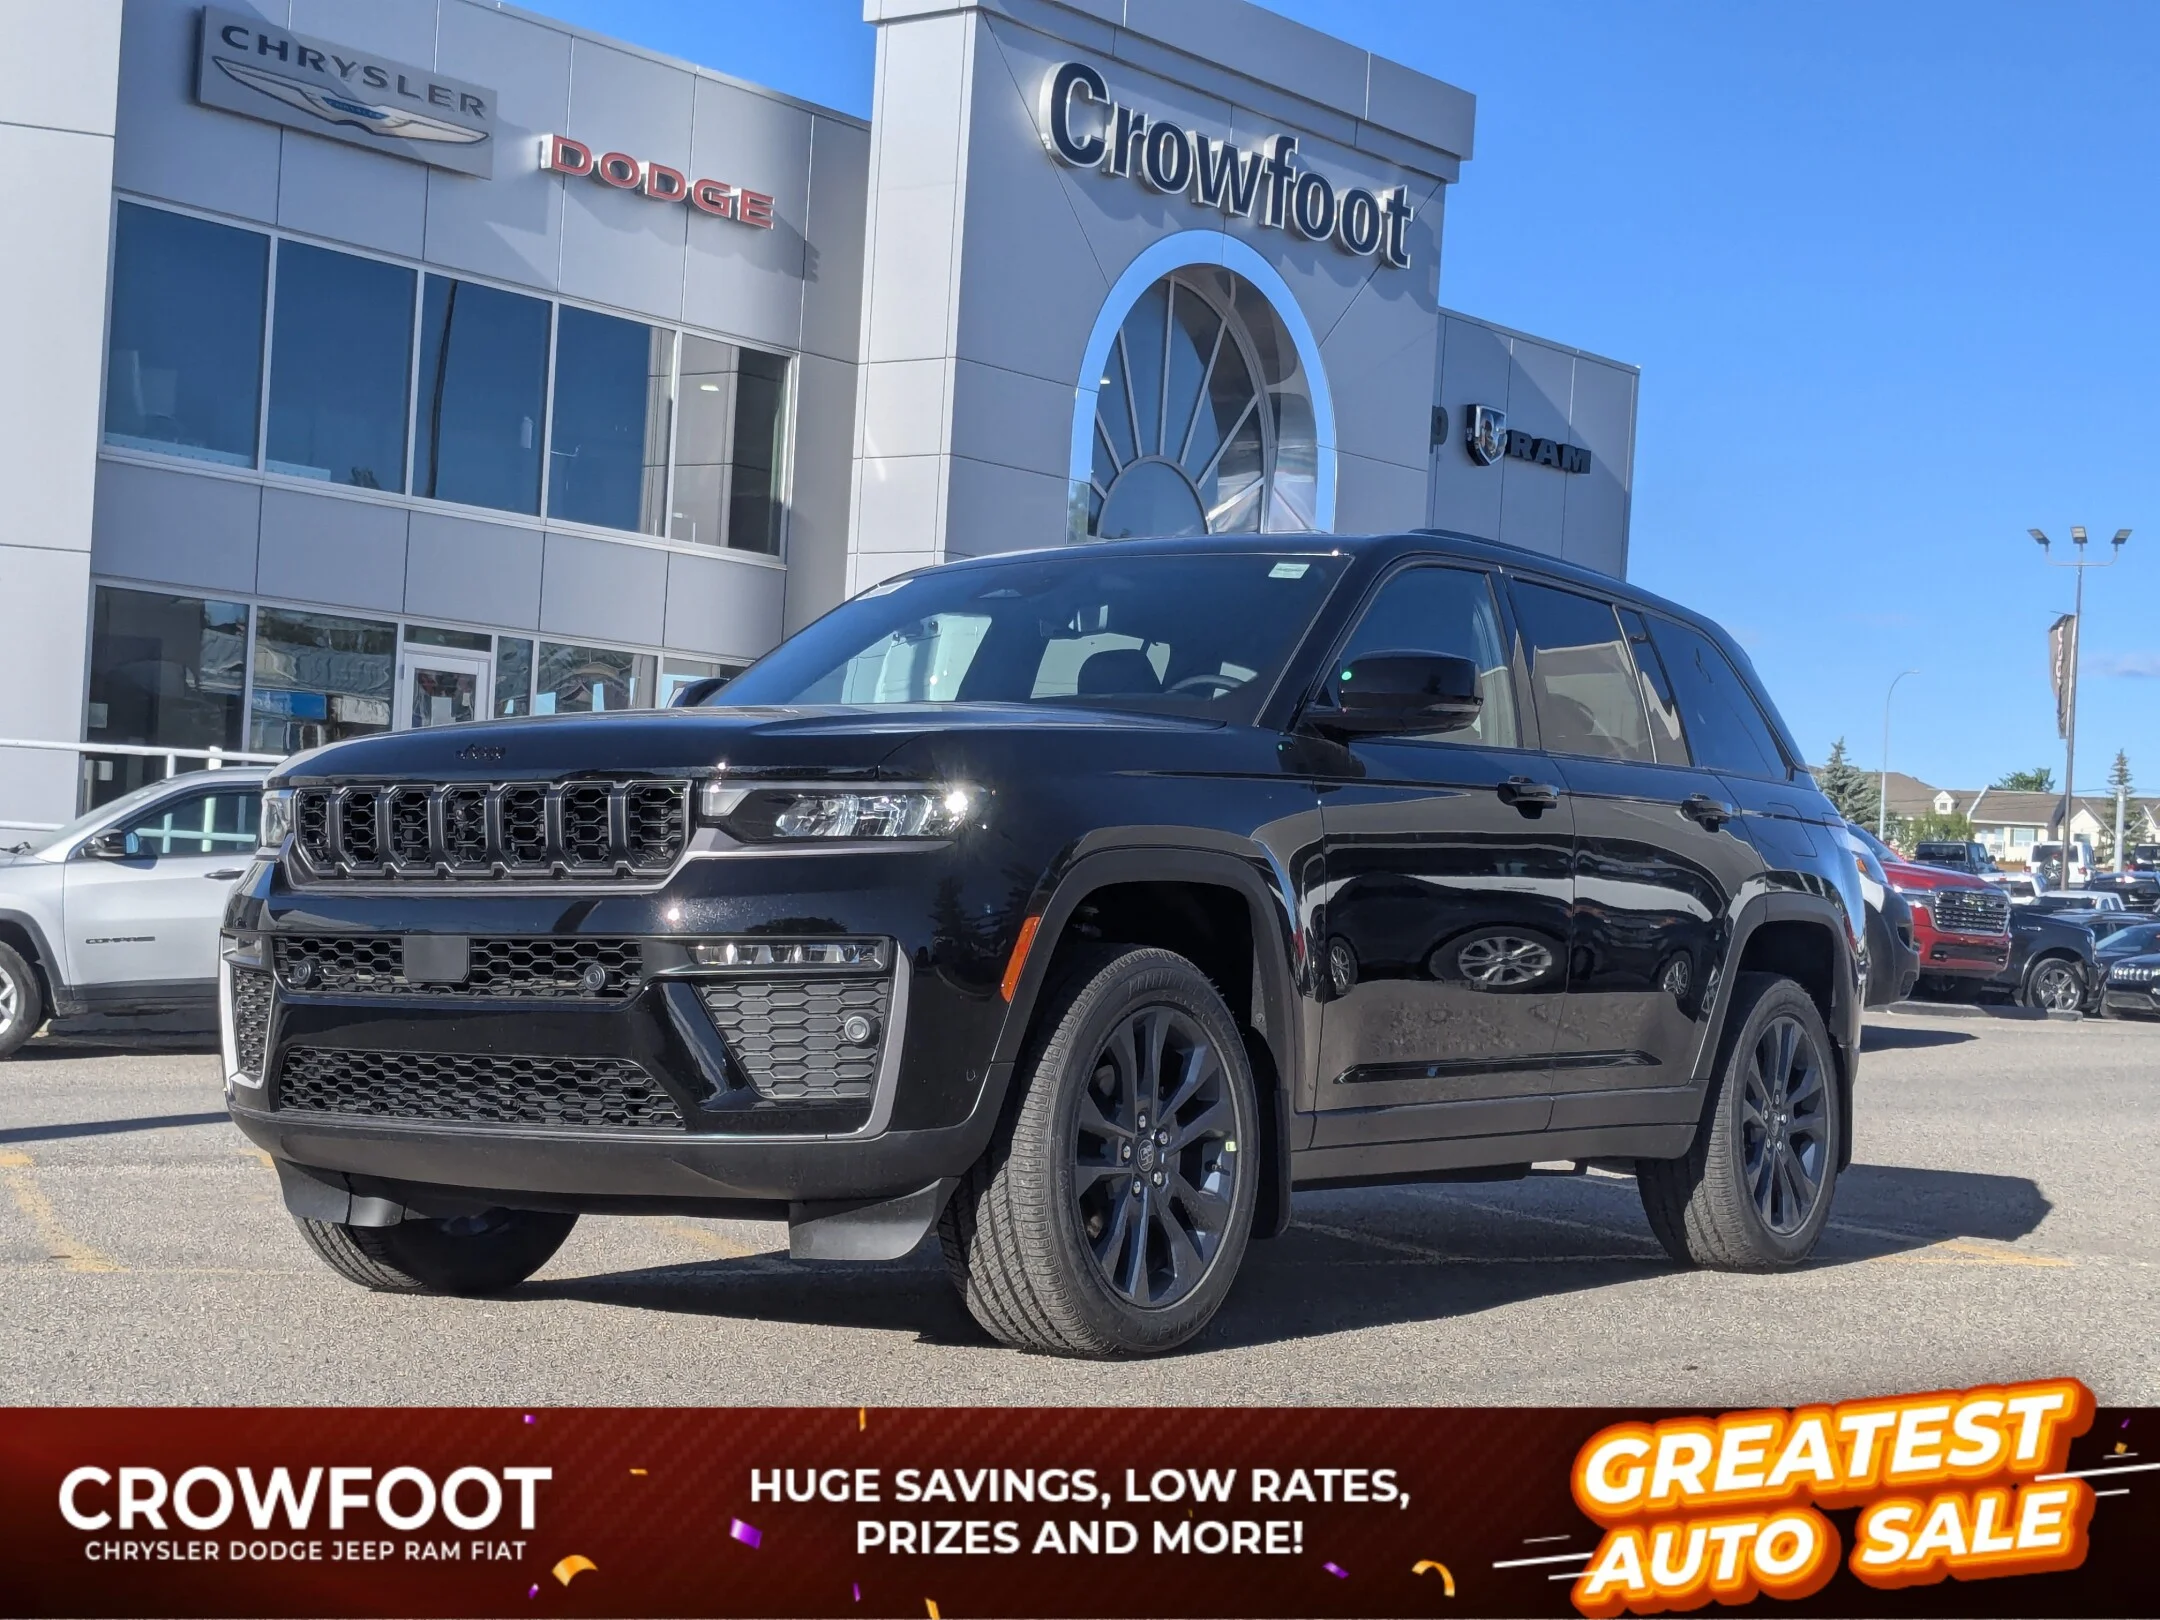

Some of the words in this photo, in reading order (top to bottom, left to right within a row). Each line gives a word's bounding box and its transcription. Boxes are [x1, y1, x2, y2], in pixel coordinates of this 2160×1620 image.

[221, 25, 488, 119] CHRYSLER
[543, 134, 776, 230] DODGE
[1039, 60, 1414, 270] Crowfoot
[1507, 429, 1592, 475] RAM
